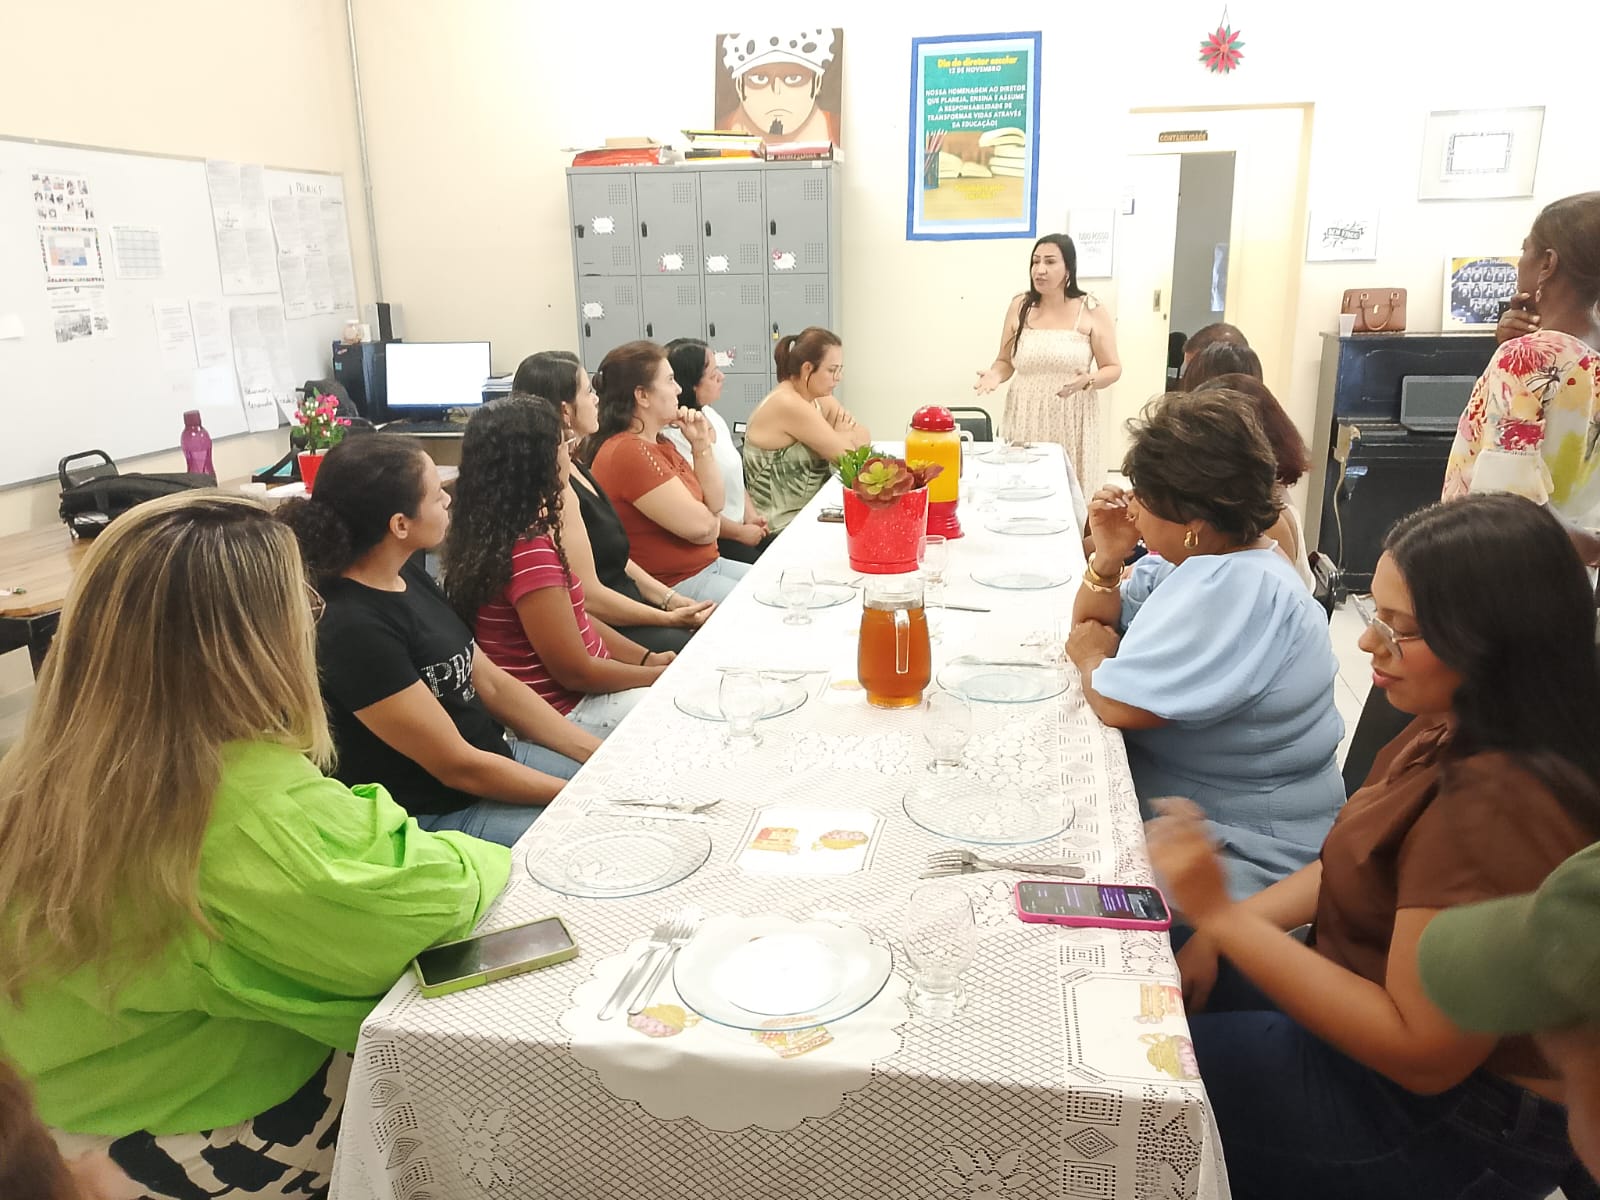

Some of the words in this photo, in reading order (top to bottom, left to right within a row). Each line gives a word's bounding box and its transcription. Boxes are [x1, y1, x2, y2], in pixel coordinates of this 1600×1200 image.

[938, 58, 950, 68] Dia
[952, 57, 962, 66] do
[963, 57, 989, 66] diretor
[990, 56, 1018, 64] escolar
[948, 87, 988, 95] HOMENAGEM
[928, 98, 940, 106] QUE
[944, 103, 1003, 112] RESPONSABILIDADE
[928, 113, 972, 121] TRANSFORMAR
[994, 109, 1022, 118] ATRAVÉS
